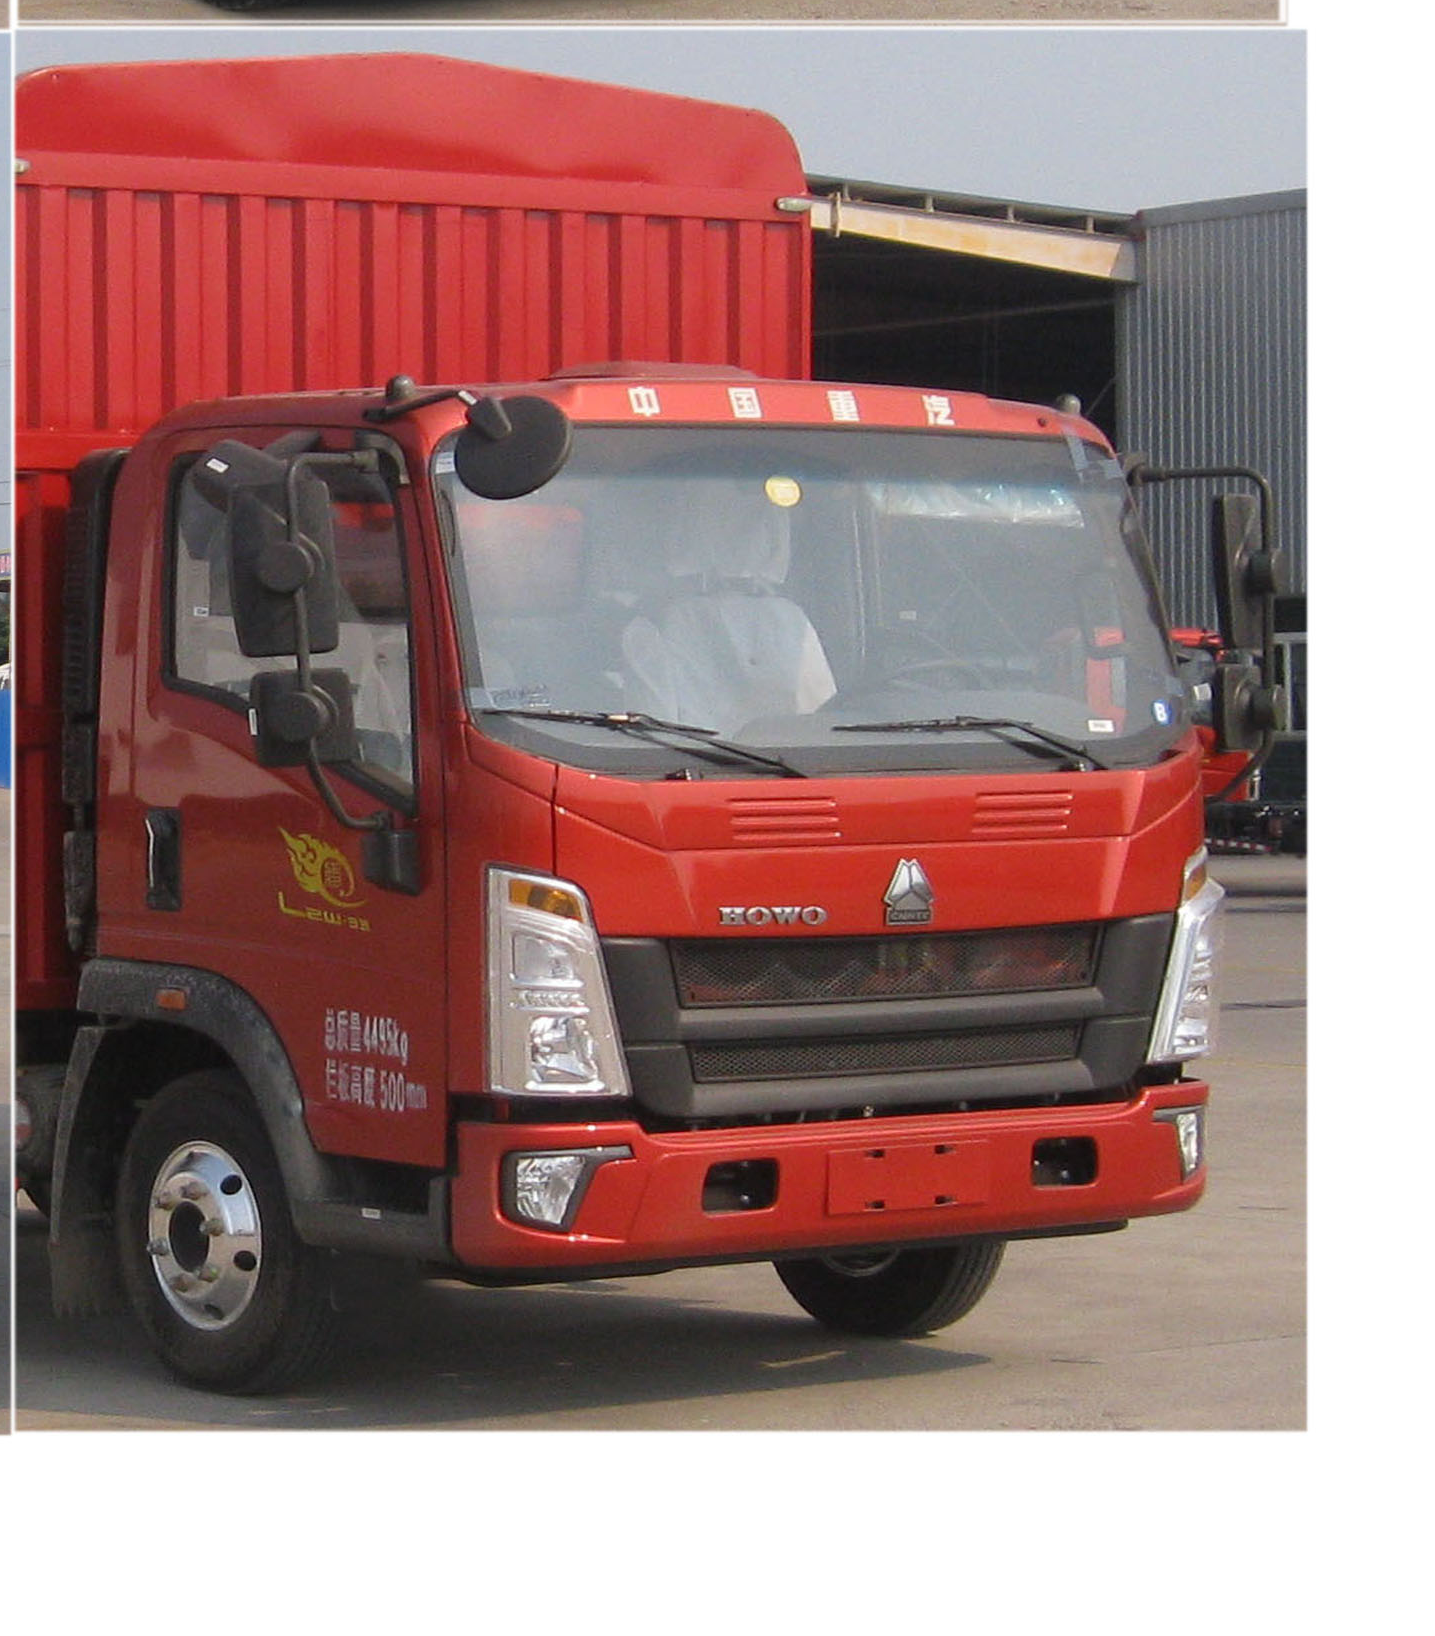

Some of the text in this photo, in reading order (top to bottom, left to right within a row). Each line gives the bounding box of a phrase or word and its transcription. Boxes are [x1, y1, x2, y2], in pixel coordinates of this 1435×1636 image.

[627, 386, 956, 426] 中国重汽
[718, 906, 828, 926] HOWO
